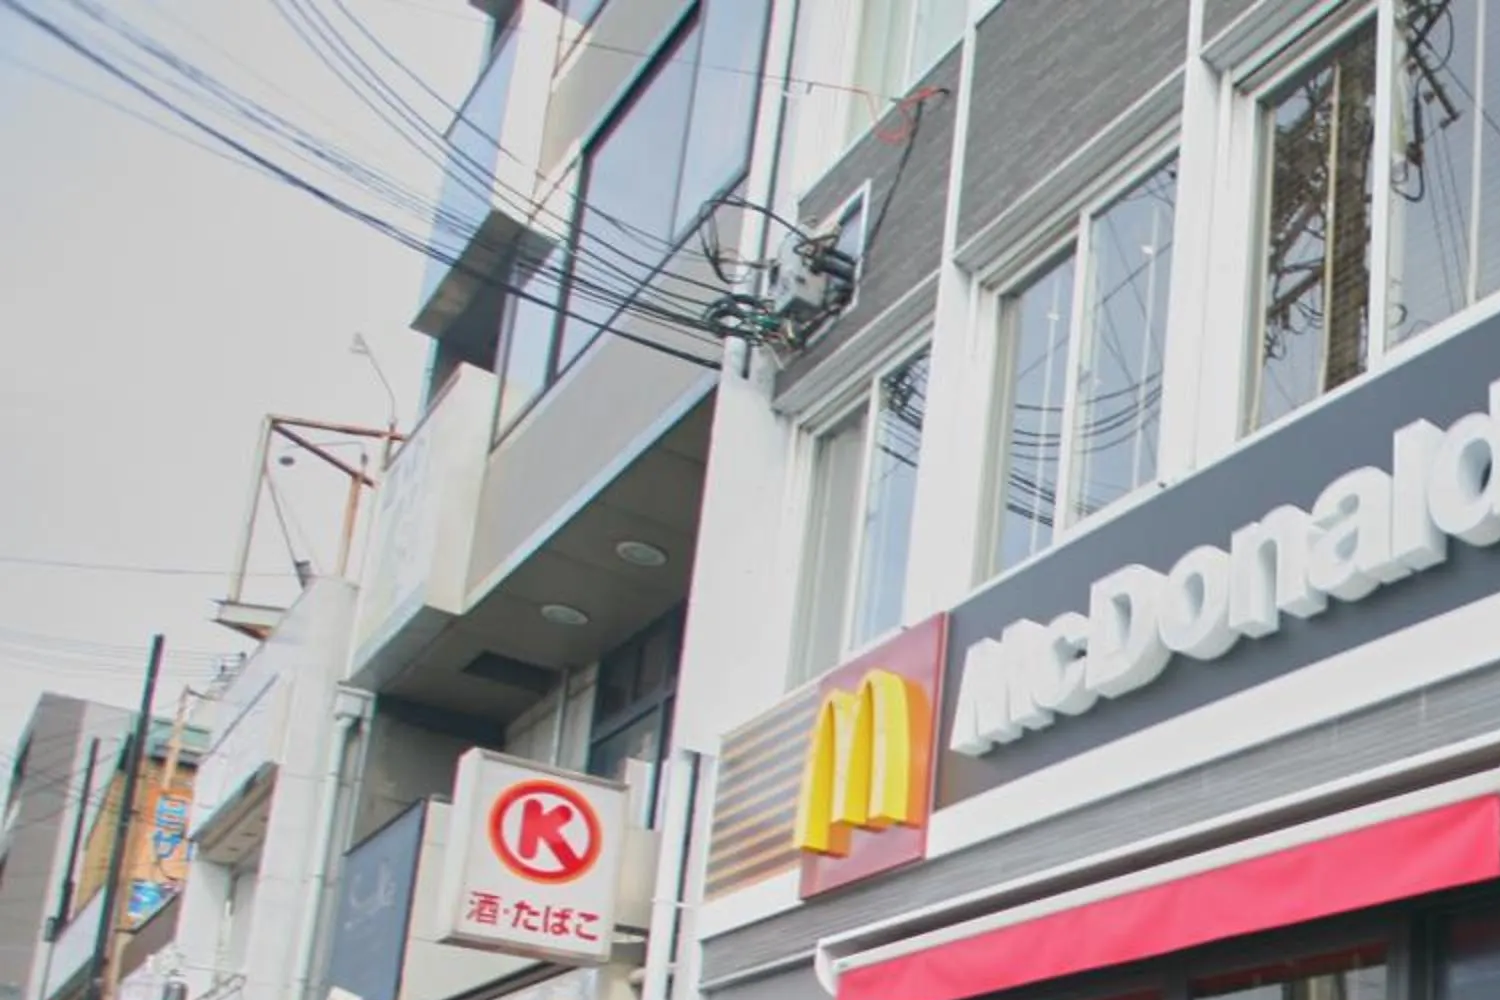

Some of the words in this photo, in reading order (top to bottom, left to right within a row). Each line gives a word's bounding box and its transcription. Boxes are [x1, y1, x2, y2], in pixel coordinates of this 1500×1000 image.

[466, 891, 600, 942] 酒・たばこ
